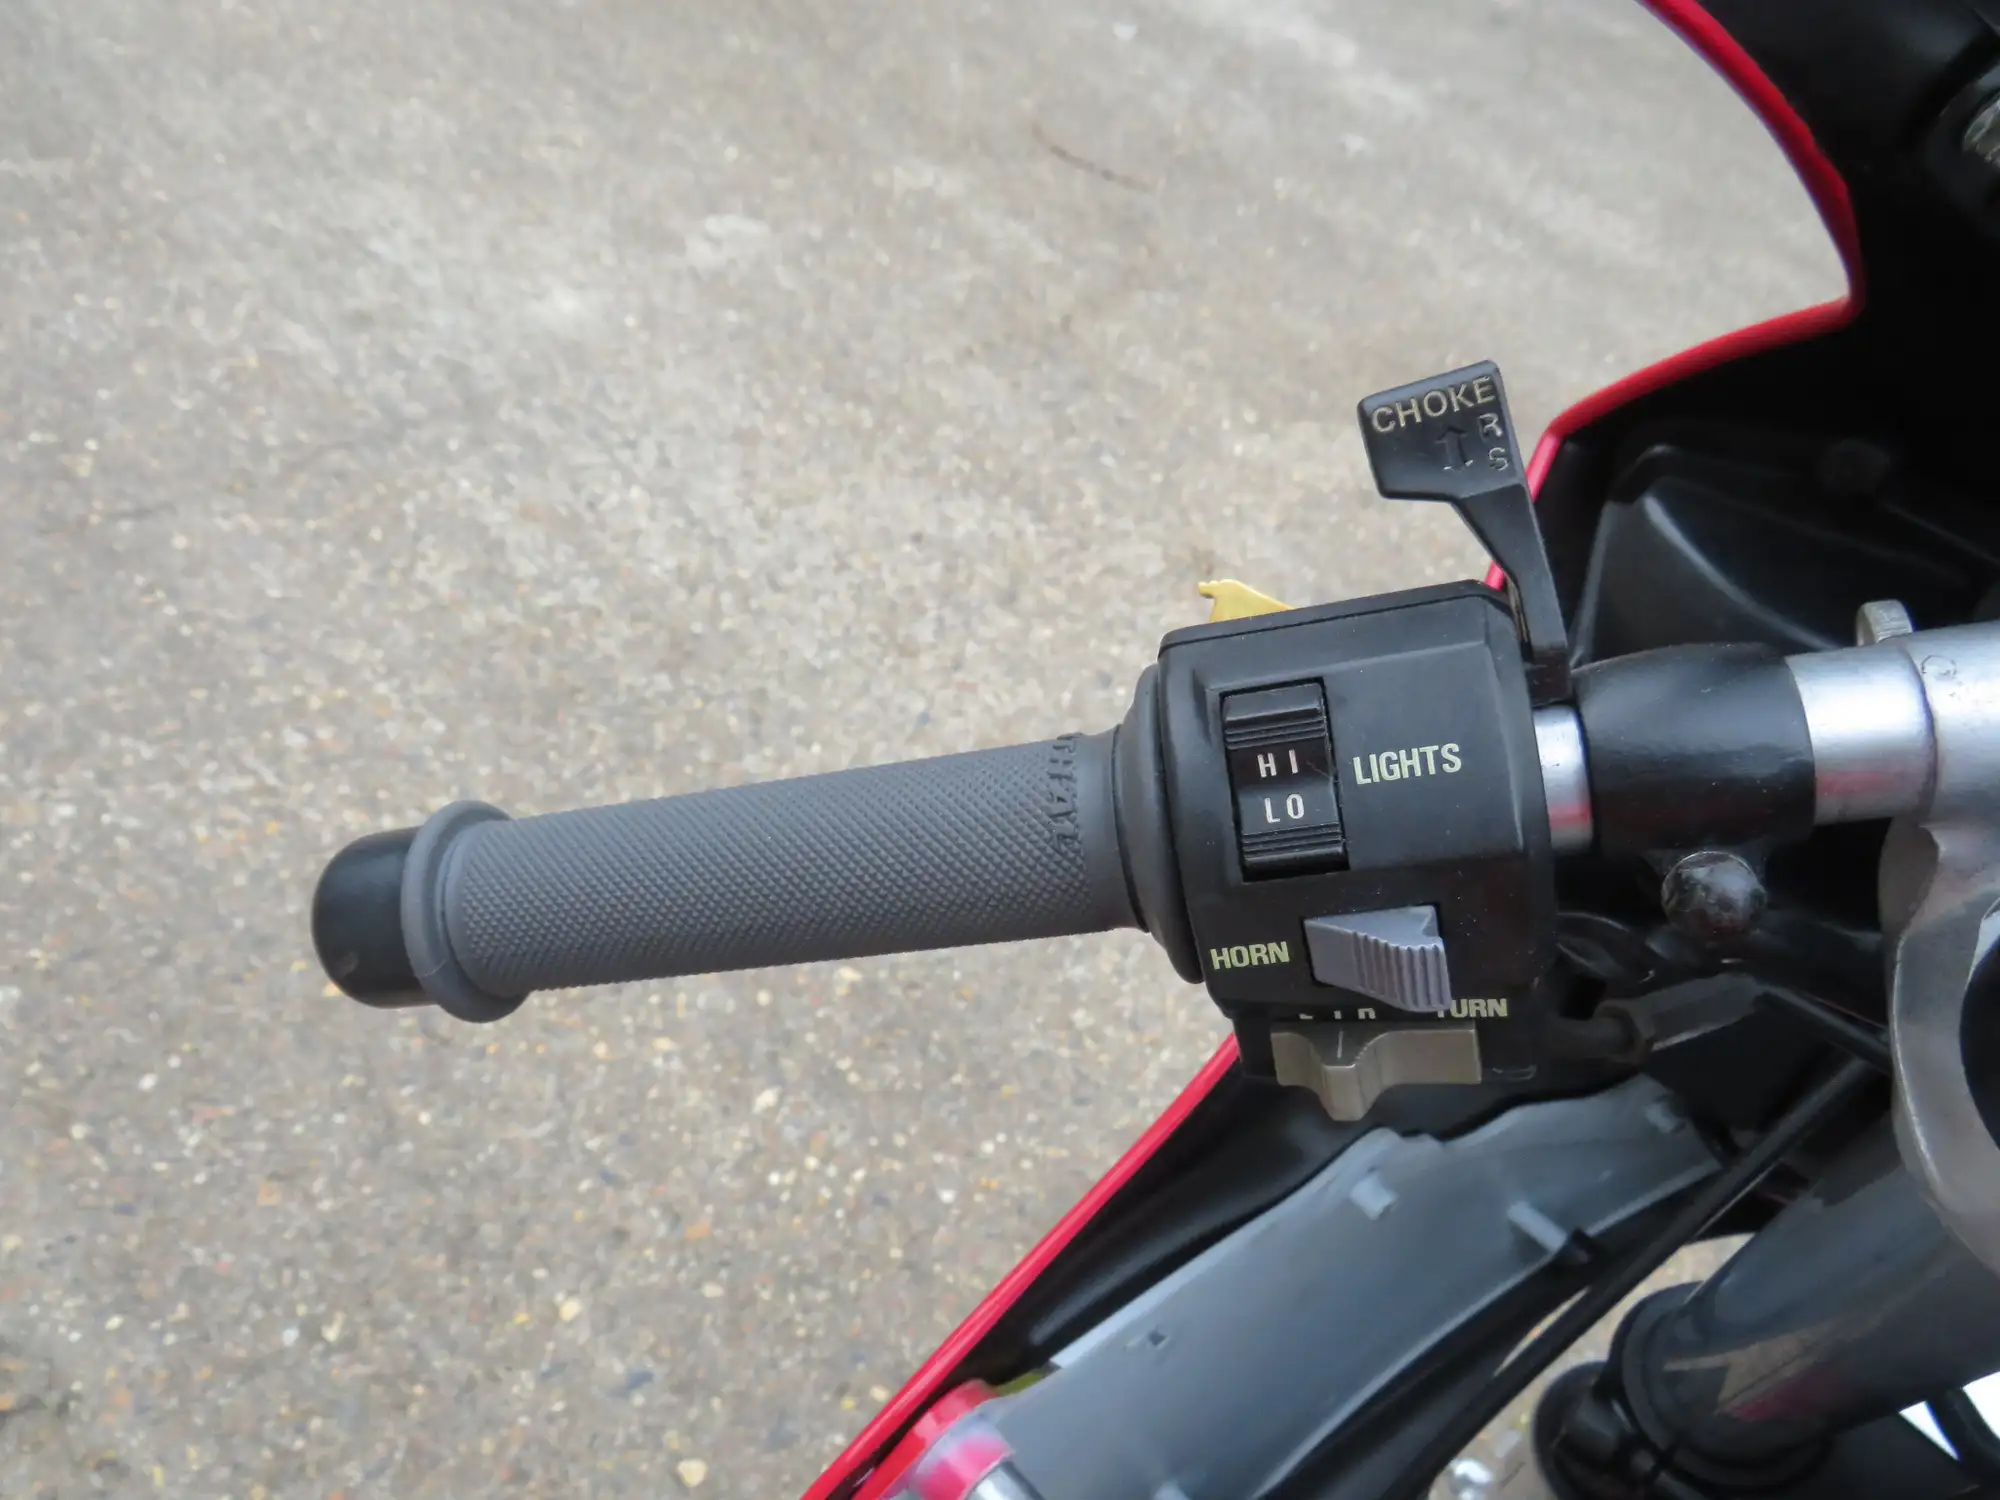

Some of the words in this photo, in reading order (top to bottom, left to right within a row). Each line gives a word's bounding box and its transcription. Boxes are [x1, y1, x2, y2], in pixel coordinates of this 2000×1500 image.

[1372, 375, 1496, 433] CHOKE
[1478, 412, 1503, 442] R
[1488, 447, 1509, 471] S
[1353, 743, 1462, 785] LIGHTS
[1210, 941, 1290, 970] HORN
